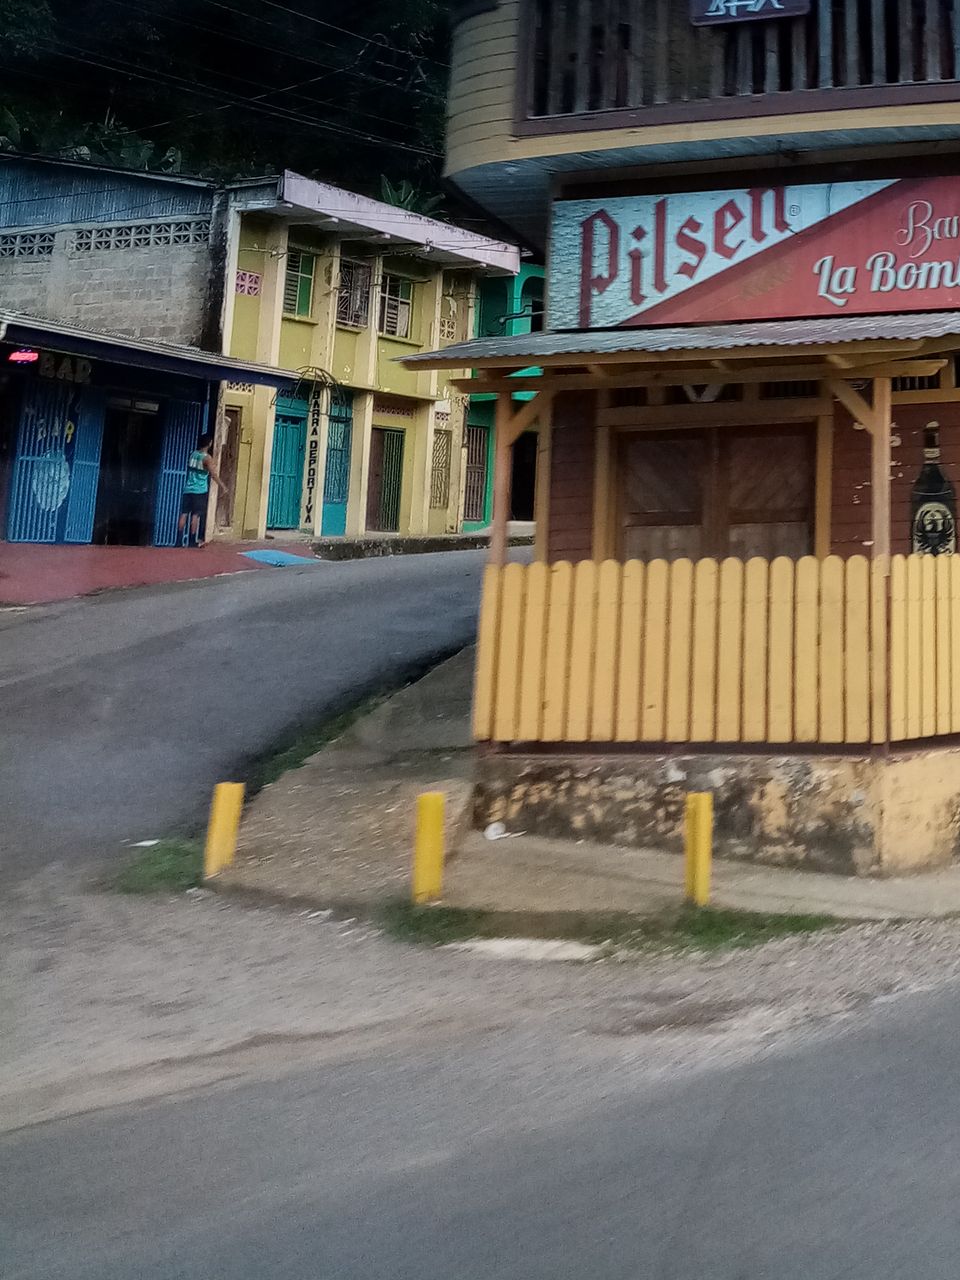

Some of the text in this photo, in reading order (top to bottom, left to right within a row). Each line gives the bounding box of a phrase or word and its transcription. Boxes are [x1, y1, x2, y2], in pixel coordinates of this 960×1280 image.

[579, 187, 791, 328] Pilsen
[813, 255, 857, 307] La
[304, 439, 318, 524] DEPORTIVA
